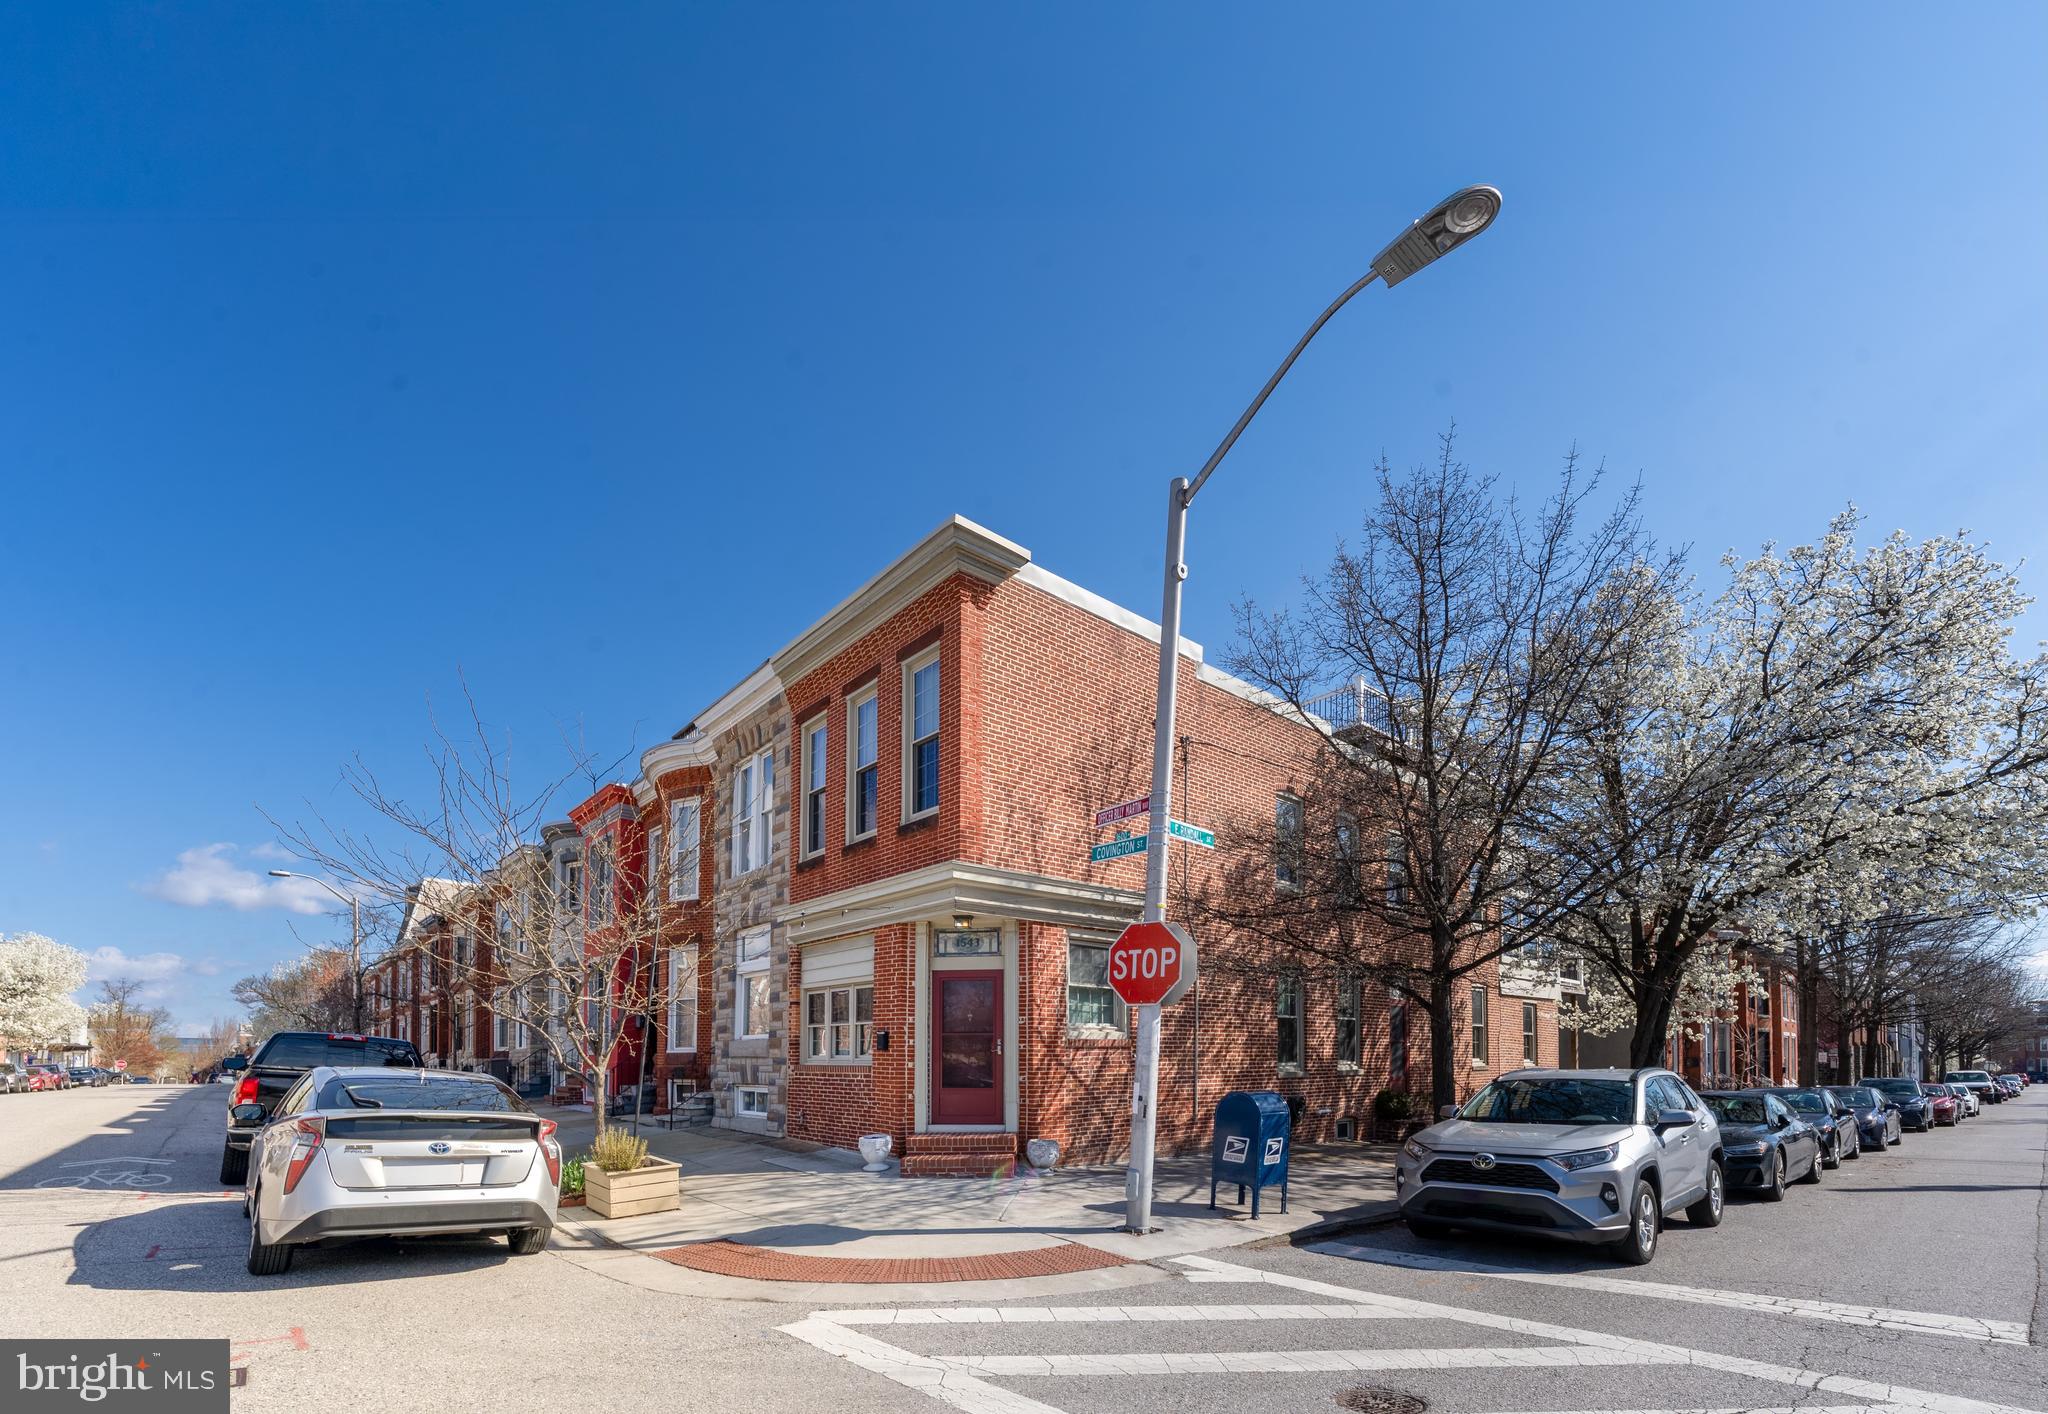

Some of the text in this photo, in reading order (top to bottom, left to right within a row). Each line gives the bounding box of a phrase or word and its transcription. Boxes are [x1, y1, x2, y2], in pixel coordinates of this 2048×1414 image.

[1098, 810, 1114, 825] OFFICER
[1174, 823, 1180, 835] E
[1096, 839, 1144, 860] COVINGTON ST
[1113, 947, 1177, 980] STOP
